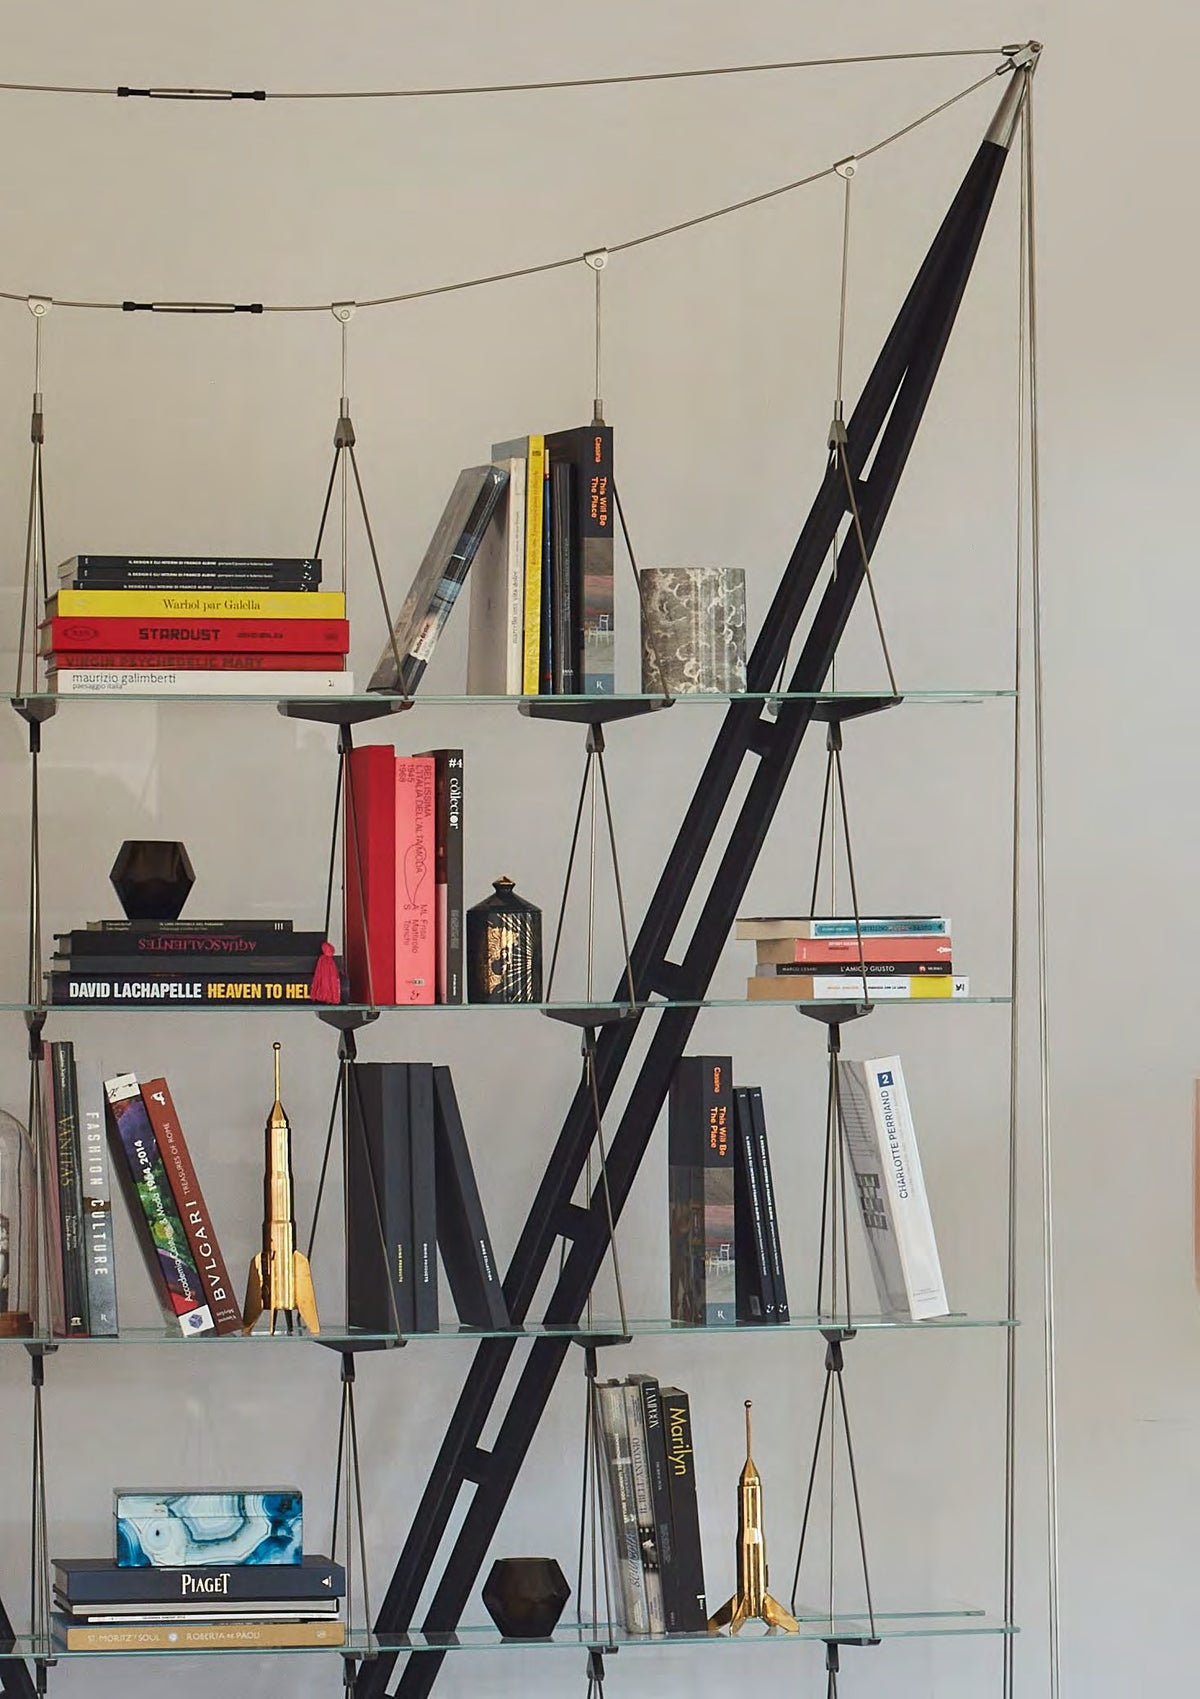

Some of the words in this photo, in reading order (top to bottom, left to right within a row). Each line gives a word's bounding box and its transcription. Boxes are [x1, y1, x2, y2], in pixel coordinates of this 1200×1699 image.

[591, 477, 599, 493] The
[599, 477, 608, 496] This
[591, 494, 599, 518] Place
[599, 497, 608, 513] Will
[599, 514, 607, 526] Be
[163, 599, 200, 611] Warhol
[203, 601, 221, 613] par
[223, 600, 261, 611] Galella
[139, 629, 221, 641] STARDUST
[72, 672, 119, 683] maurizio
[121, 673, 176, 686] galimberti
[407, 763, 415, 783] 1945
[448, 758, 463, 769] #4
[424, 764, 432, 818] BELLISSIMA
[449, 777, 462, 830] collector
[415, 847, 424, 873] MODA
[138, 937, 257, 952] AGUASCALIENTES
[840, 965, 868, 973] L'AMICO
[70, 982, 110, 999] DAVID
[113, 982, 202, 999] LACHAPELLE
[207, 983, 262, 999] HEAVEN
[265, 983, 283, 999] TO
[882, 1073, 889, 1085] 2
[710, 1106, 718, 1124] The
[718, 1106, 727, 1125] This
[880, 1090, 898, 1141] PERRIAND
[162, 1122, 174, 1143] ROME
[710, 1125, 719, 1148] Place
[718, 1125, 727, 1143] Will
[58, 1114, 74, 1187] VANITAS
[86, 1112, 104, 1185] FASHION
[169, 1143, 178, 1155] OF
[719, 1144, 727, 1157] Be
[173, 1156, 191, 1196] TREASURES
[890, 1141, 909, 1200] CHARLOTTE
[90, 1199, 108, 1275] CULTURE
[185, 1200, 227, 1301] BVLGARI
[669, 1407, 693, 1477] Marilyn
[181, 1573, 231, 1595] PIAGET
[186, 1632, 225, 1641] ROBERTA
